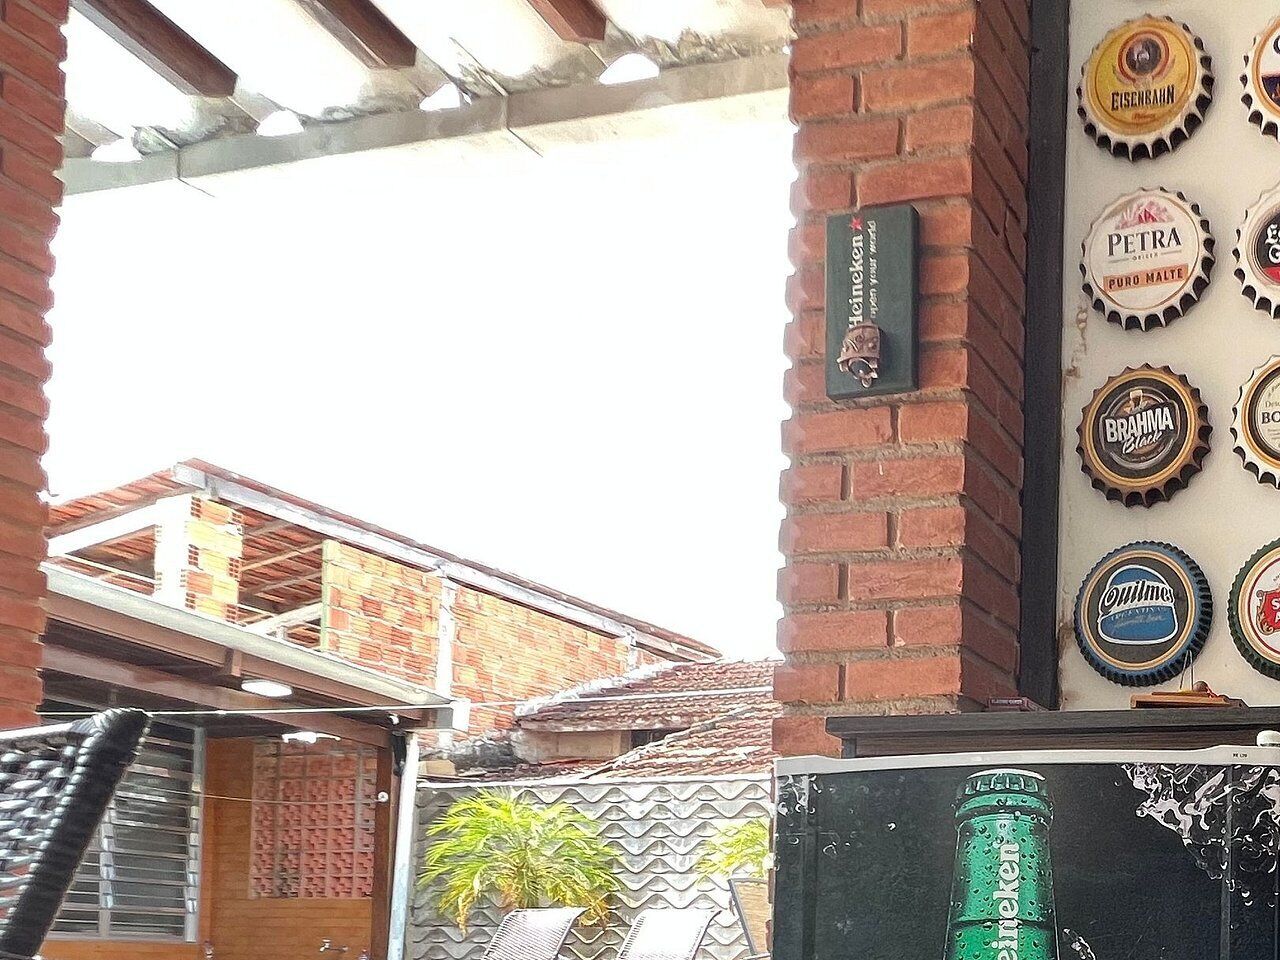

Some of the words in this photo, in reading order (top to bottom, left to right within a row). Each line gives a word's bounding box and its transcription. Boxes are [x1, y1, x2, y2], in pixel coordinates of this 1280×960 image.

[1111, 84, 1175, 111] EISENBAHN
[1107, 227, 1182, 256] PETRA
[848, 234, 864, 329] Heineken
[1108, 274, 1140, 290] PURO
[1146, 268, 1183, 284] MALTE
[1105, 407, 1175, 442] BRAHMA
